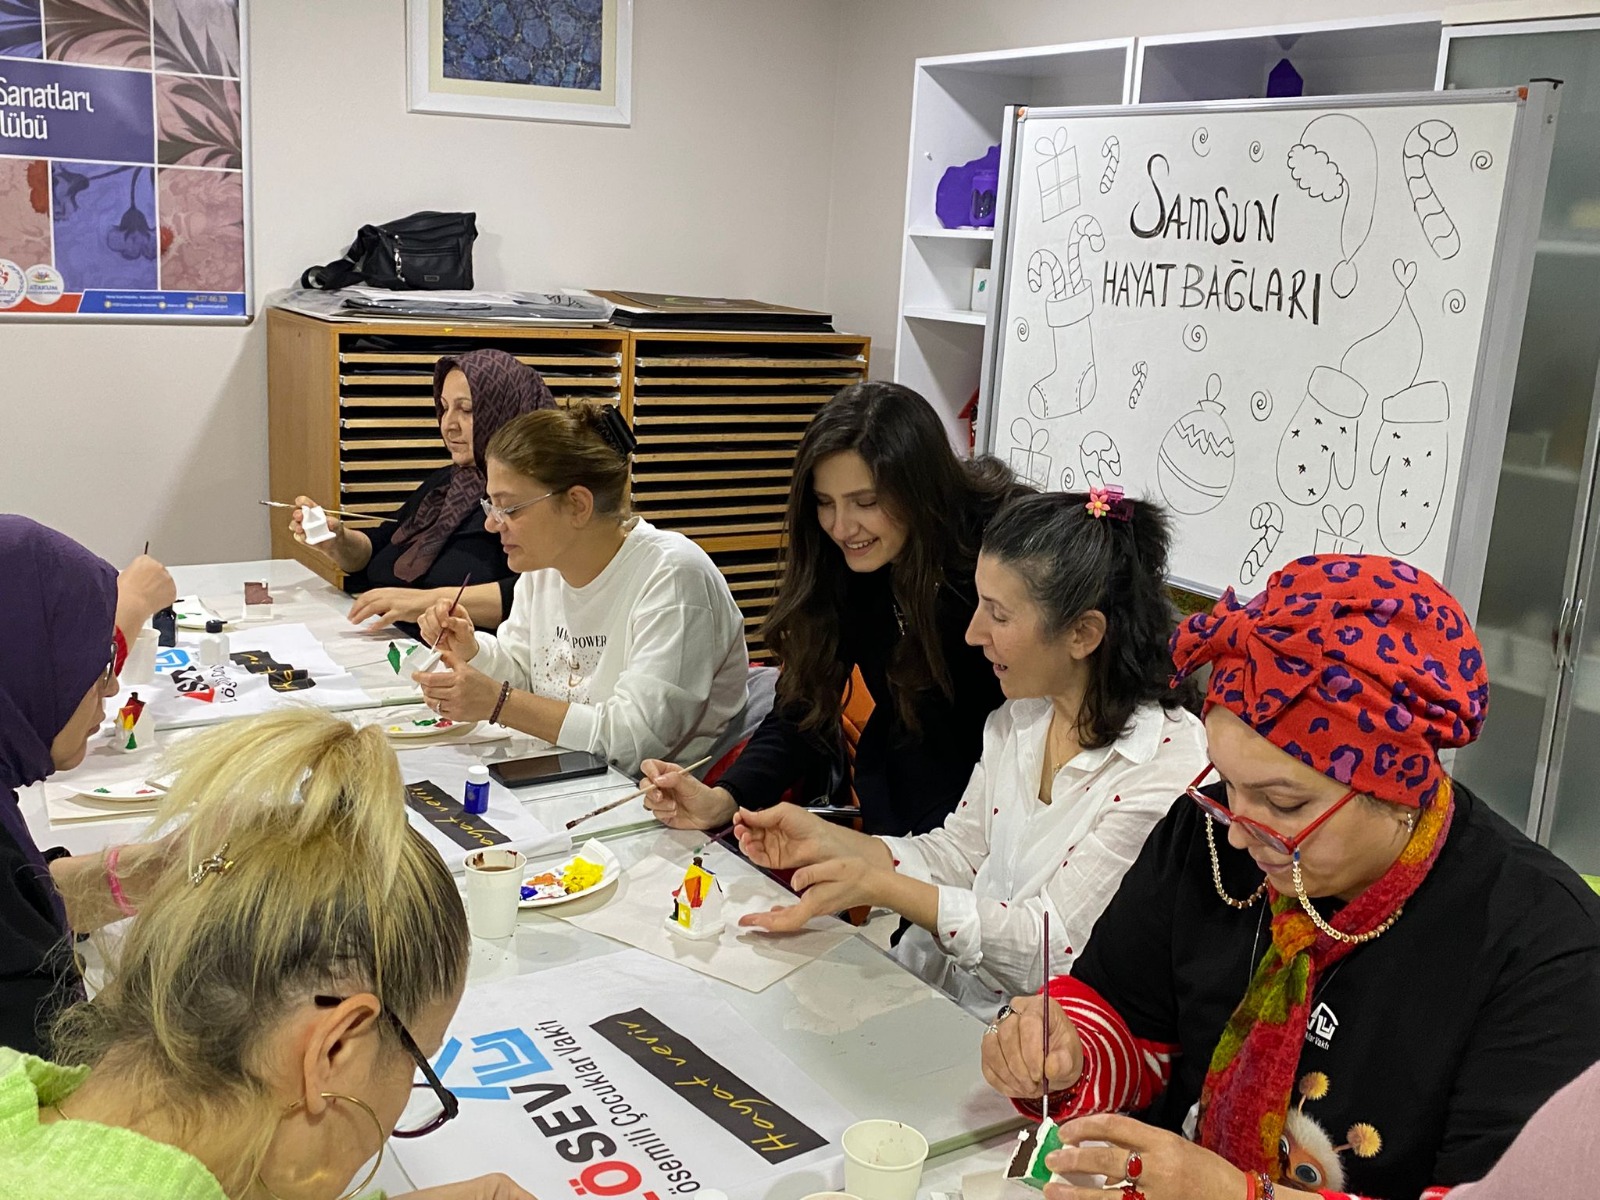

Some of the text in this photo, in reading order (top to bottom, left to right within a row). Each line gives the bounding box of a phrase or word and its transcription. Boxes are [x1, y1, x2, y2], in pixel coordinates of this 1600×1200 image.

[0, 109, 48, 139] lübü
[1101, 259, 1322, 326] HAYAT BAĞLARI
[571, 635, 607, 649] POWER
[434, 816, 500, 846] ayat
[534, 1020, 701, 1195] ösemili Çocuklar Vakfı
[616, 1020, 799, 1151] Hayat verir
[509, 1083, 661, 1200] ÖSEV
